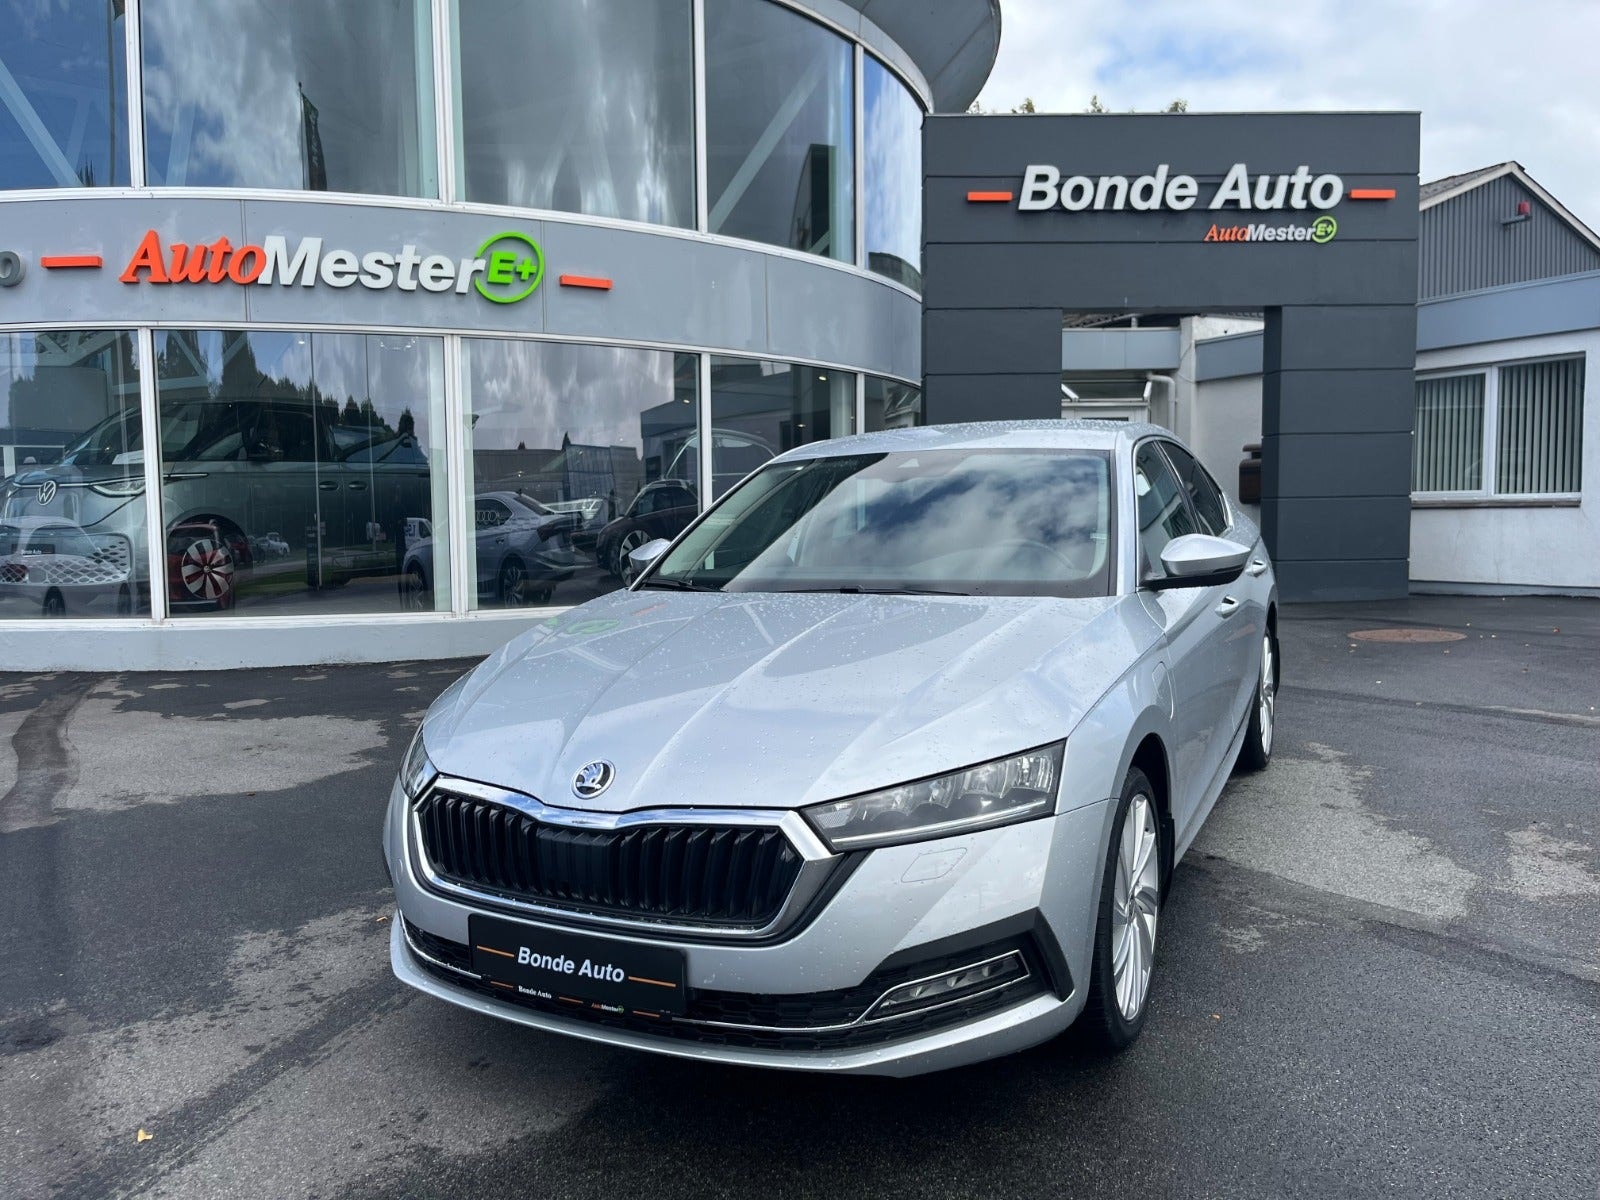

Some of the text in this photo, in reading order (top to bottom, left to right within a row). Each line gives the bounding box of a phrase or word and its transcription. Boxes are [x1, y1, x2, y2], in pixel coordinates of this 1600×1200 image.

[1018, 163, 1344, 211] Bonde Auto
[1203, 223, 1316, 242] AutoMester
[118, 229, 537, 295] AutoMester E+
[517, 946, 625, 983] Bonde Auto
[518, 985, 552, 999] Bonde Auto
